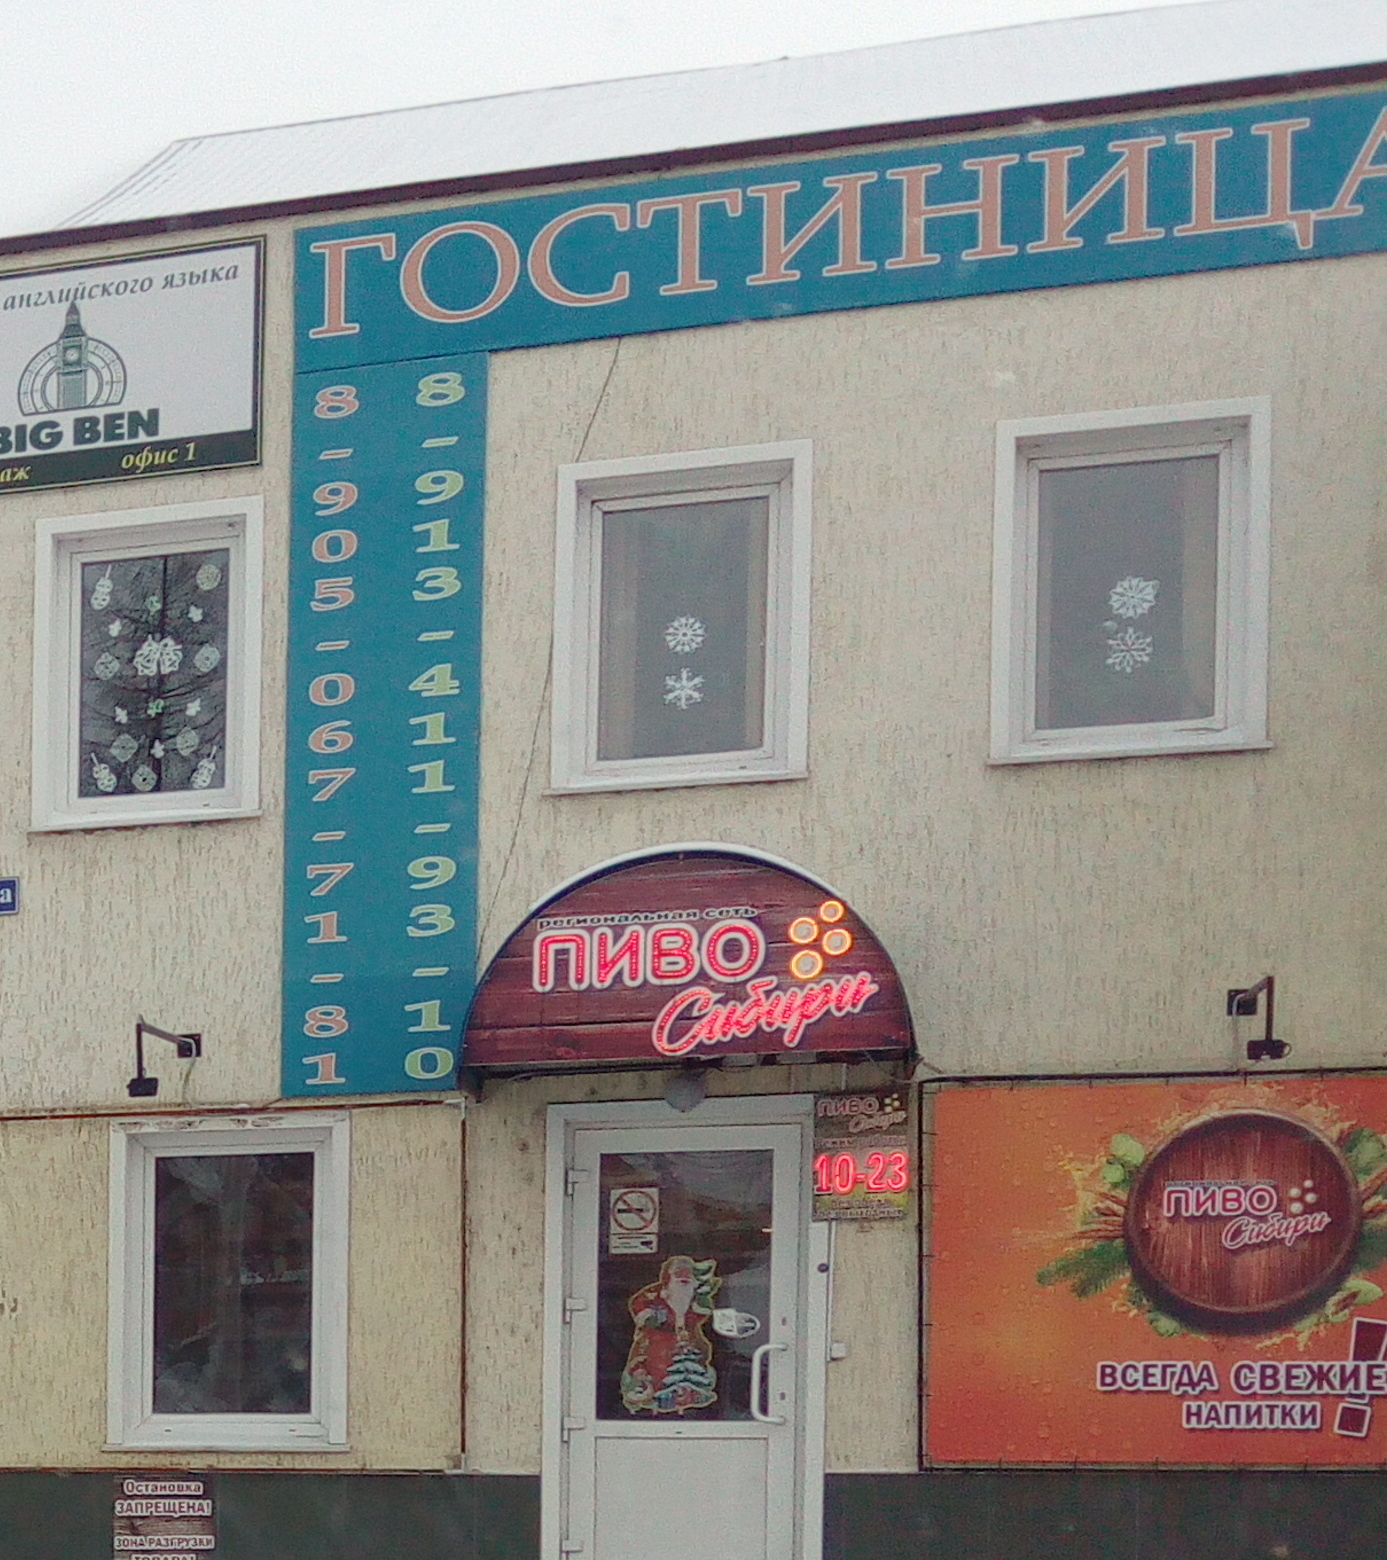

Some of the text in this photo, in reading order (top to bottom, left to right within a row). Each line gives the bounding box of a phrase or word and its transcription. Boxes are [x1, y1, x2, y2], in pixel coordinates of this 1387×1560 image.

[3, 276, 153, 309] английского
[161, 263, 240, 290] языка
[73, 408, 160, 446] BEN
[121, 443, 179, 470] офис
[184, 441, 197, 462] 1
[538, 907, 758, 930] региональная сеть
[533, 919, 765, 993] ПИВО
[652, 972, 879, 1056] Сибири
[813, 1151, 909, 1195] 10-23
[1163, 1185, 1278, 1217] ПИВО
[1222, 1211, 1332, 1249] Сибири
[1097, 1362, 1387, 1395] ВСЕГДА СВЕЖИЕ
[1183, 1401, 1321, 1429] НАПИТКИ
[125, 1480, 203, 1494] Остановка
[116, 1501, 211, 1516] ЗАПРЕЩЕНА!
[115, 1537, 214, 1549] ЗОНА РАЗГРУЗКИ
